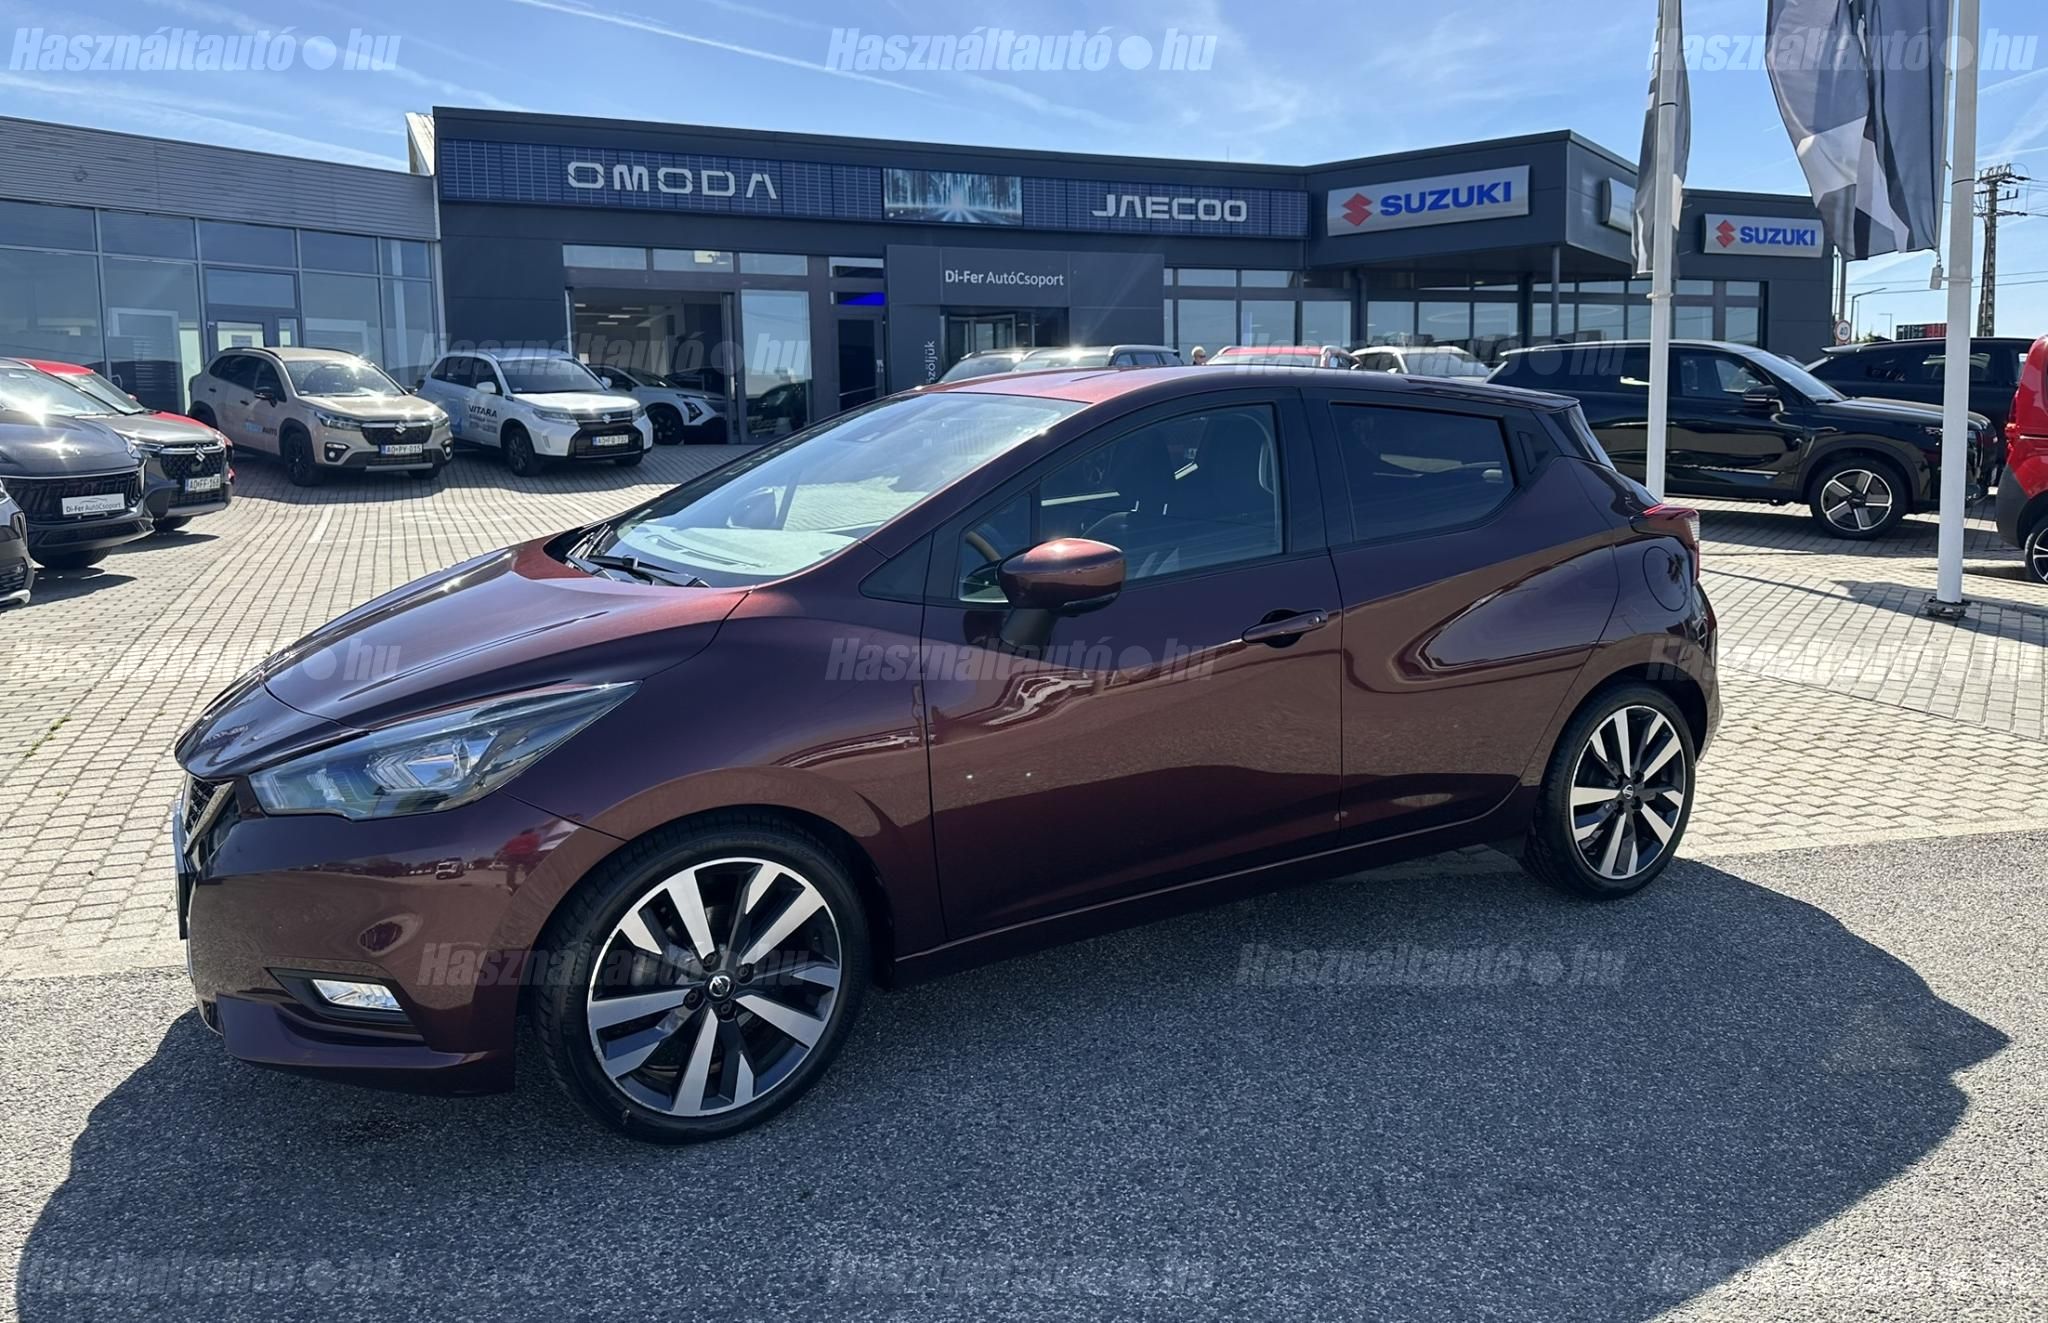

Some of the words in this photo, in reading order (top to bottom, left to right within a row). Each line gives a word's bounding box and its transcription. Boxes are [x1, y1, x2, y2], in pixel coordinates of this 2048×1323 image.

[567, 161, 777, 200] OMODA
[1091, 194, 1248, 222] JAECOO
[1380, 181, 1512, 217] SUZUKI
[1739, 226, 1816, 247] SUZUKI
[944, 269, 985, 284] Di-Fer
[986, 271, 1065, 288] AutóCsoport
[1839, 326, 1849, 337] 40
[468, 404, 498, 418] VITARA
